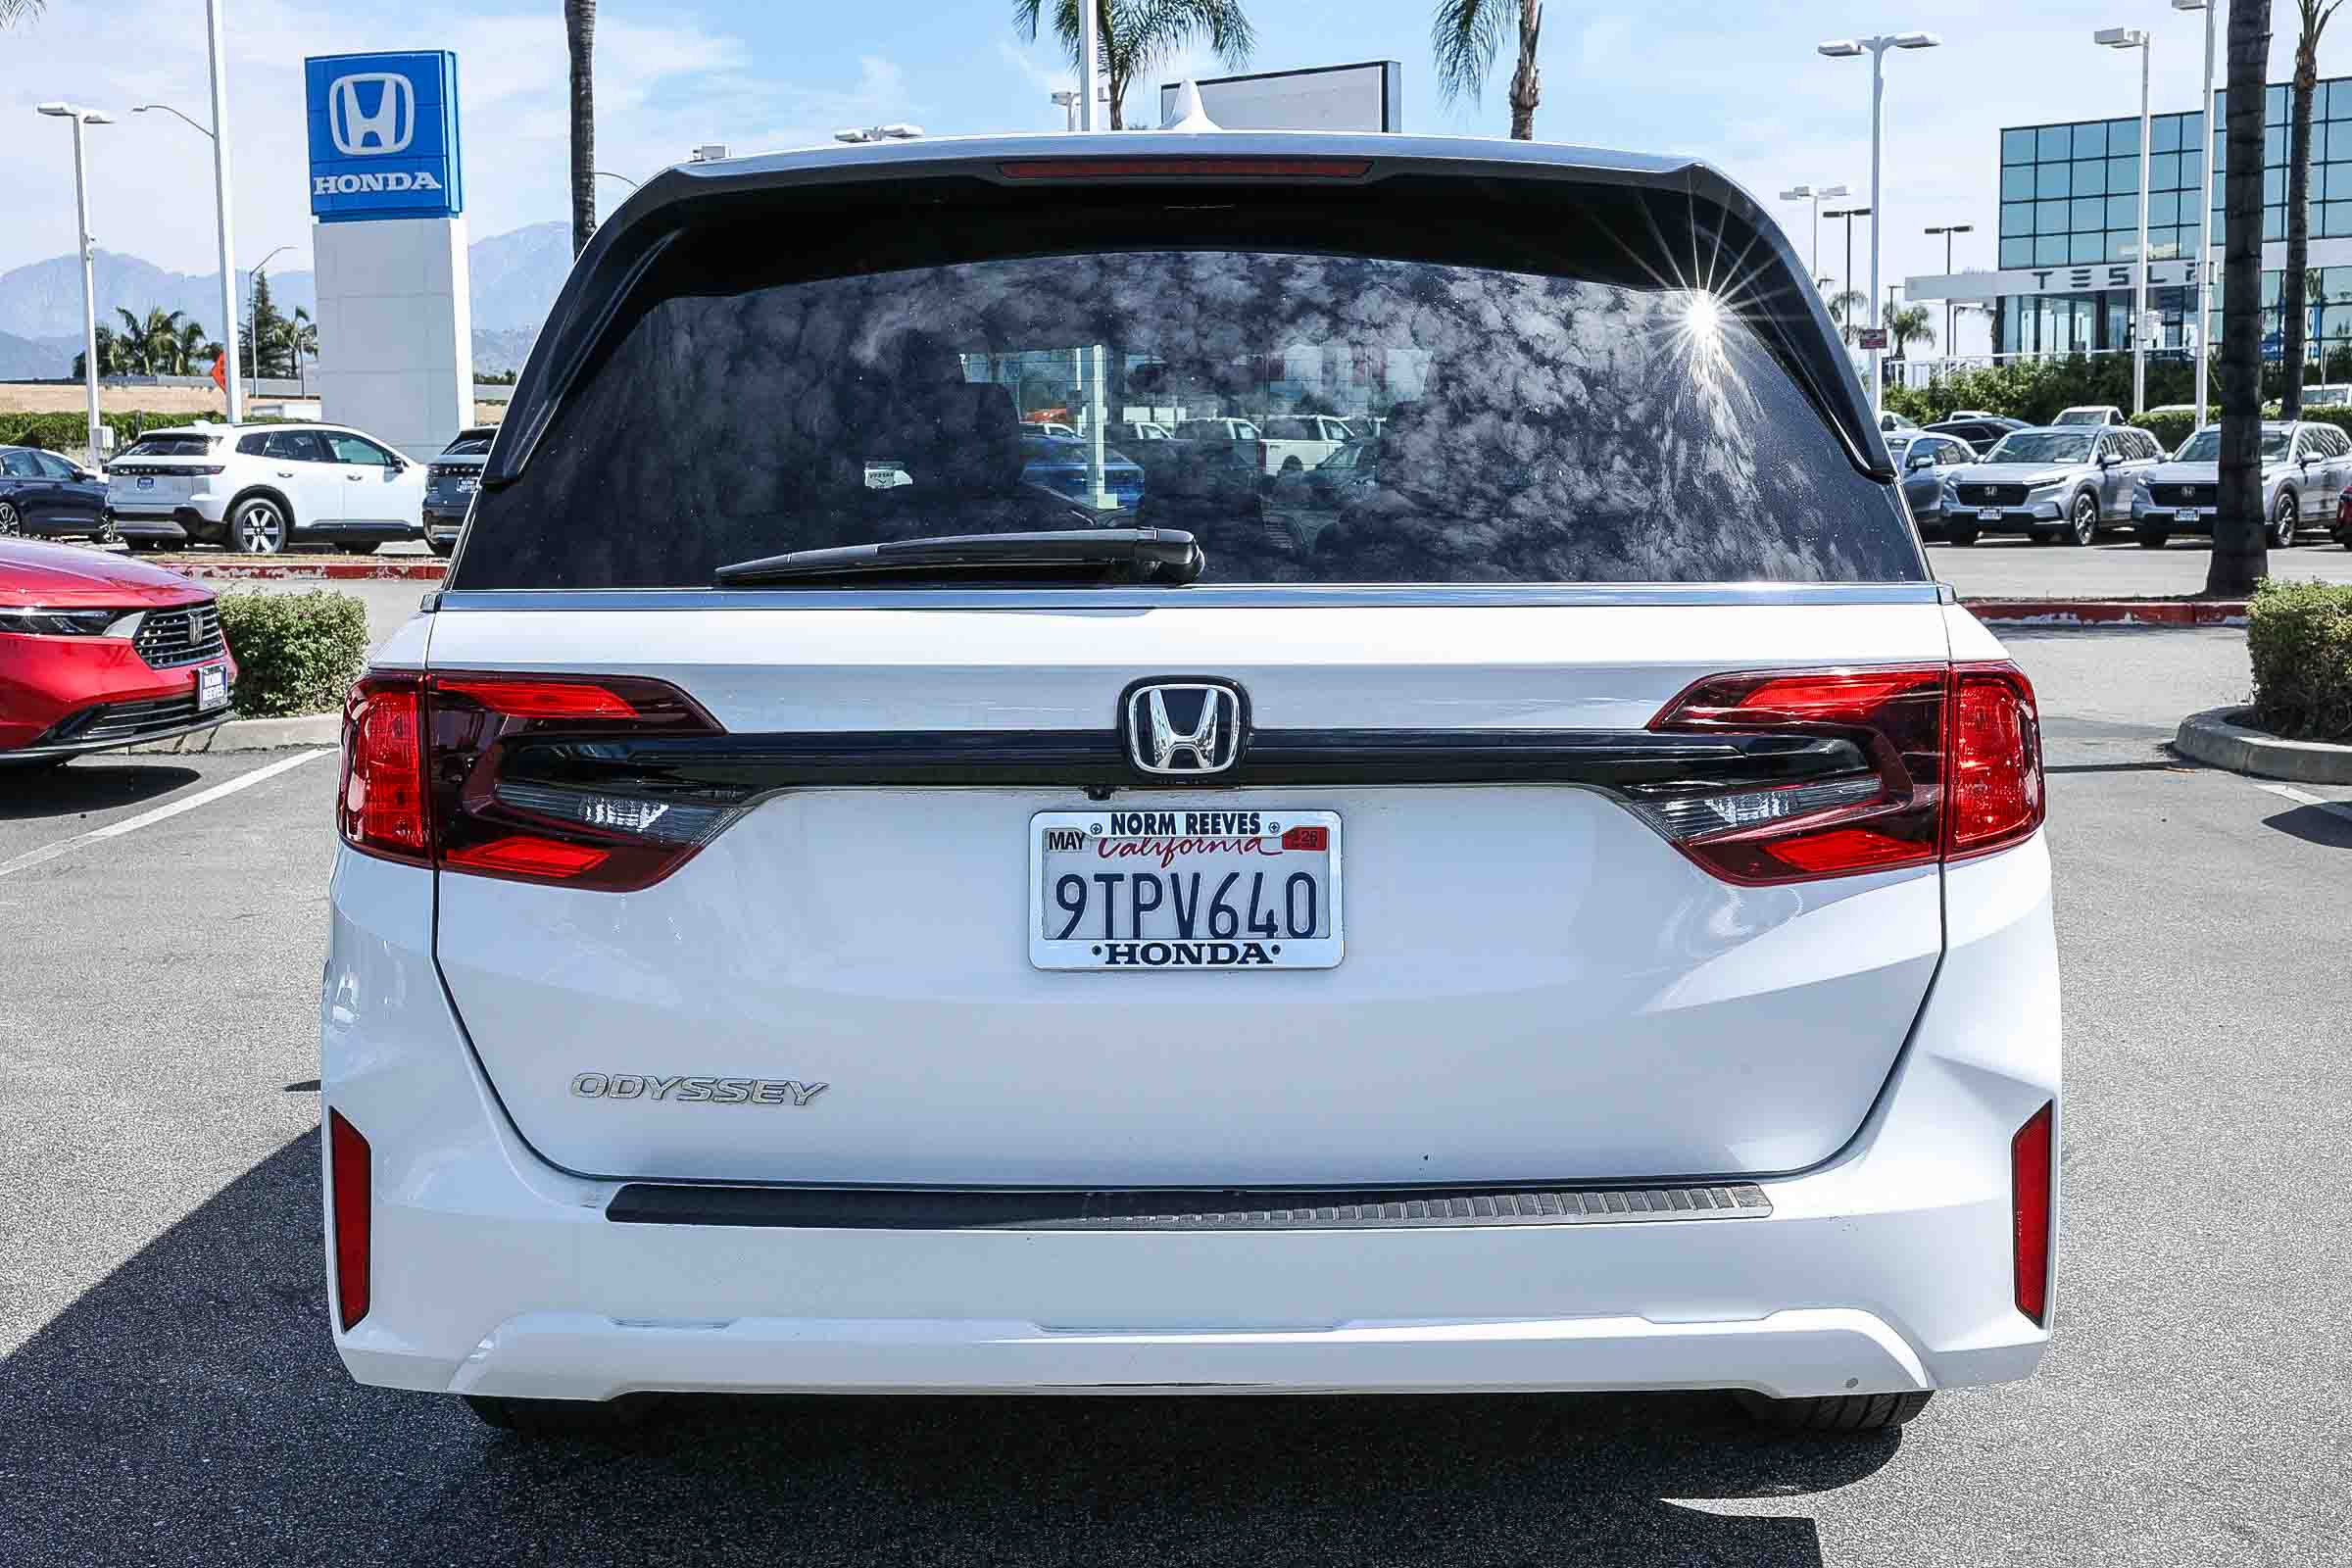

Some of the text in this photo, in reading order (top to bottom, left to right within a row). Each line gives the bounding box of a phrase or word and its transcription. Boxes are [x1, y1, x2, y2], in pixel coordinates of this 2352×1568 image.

[314, 172, 443, 195] HONDA
[1110, 812, 1261, 836] NORM REEVES
[1048, 830, 1086, 851] MAY
[1097, 837, 1284, 869] California
[1055, 870, 1317, 940] 9TPV640
[1104, 942, 1274, 966] HONDA
[571, 1072, 830, 1106] ODYSSEY
